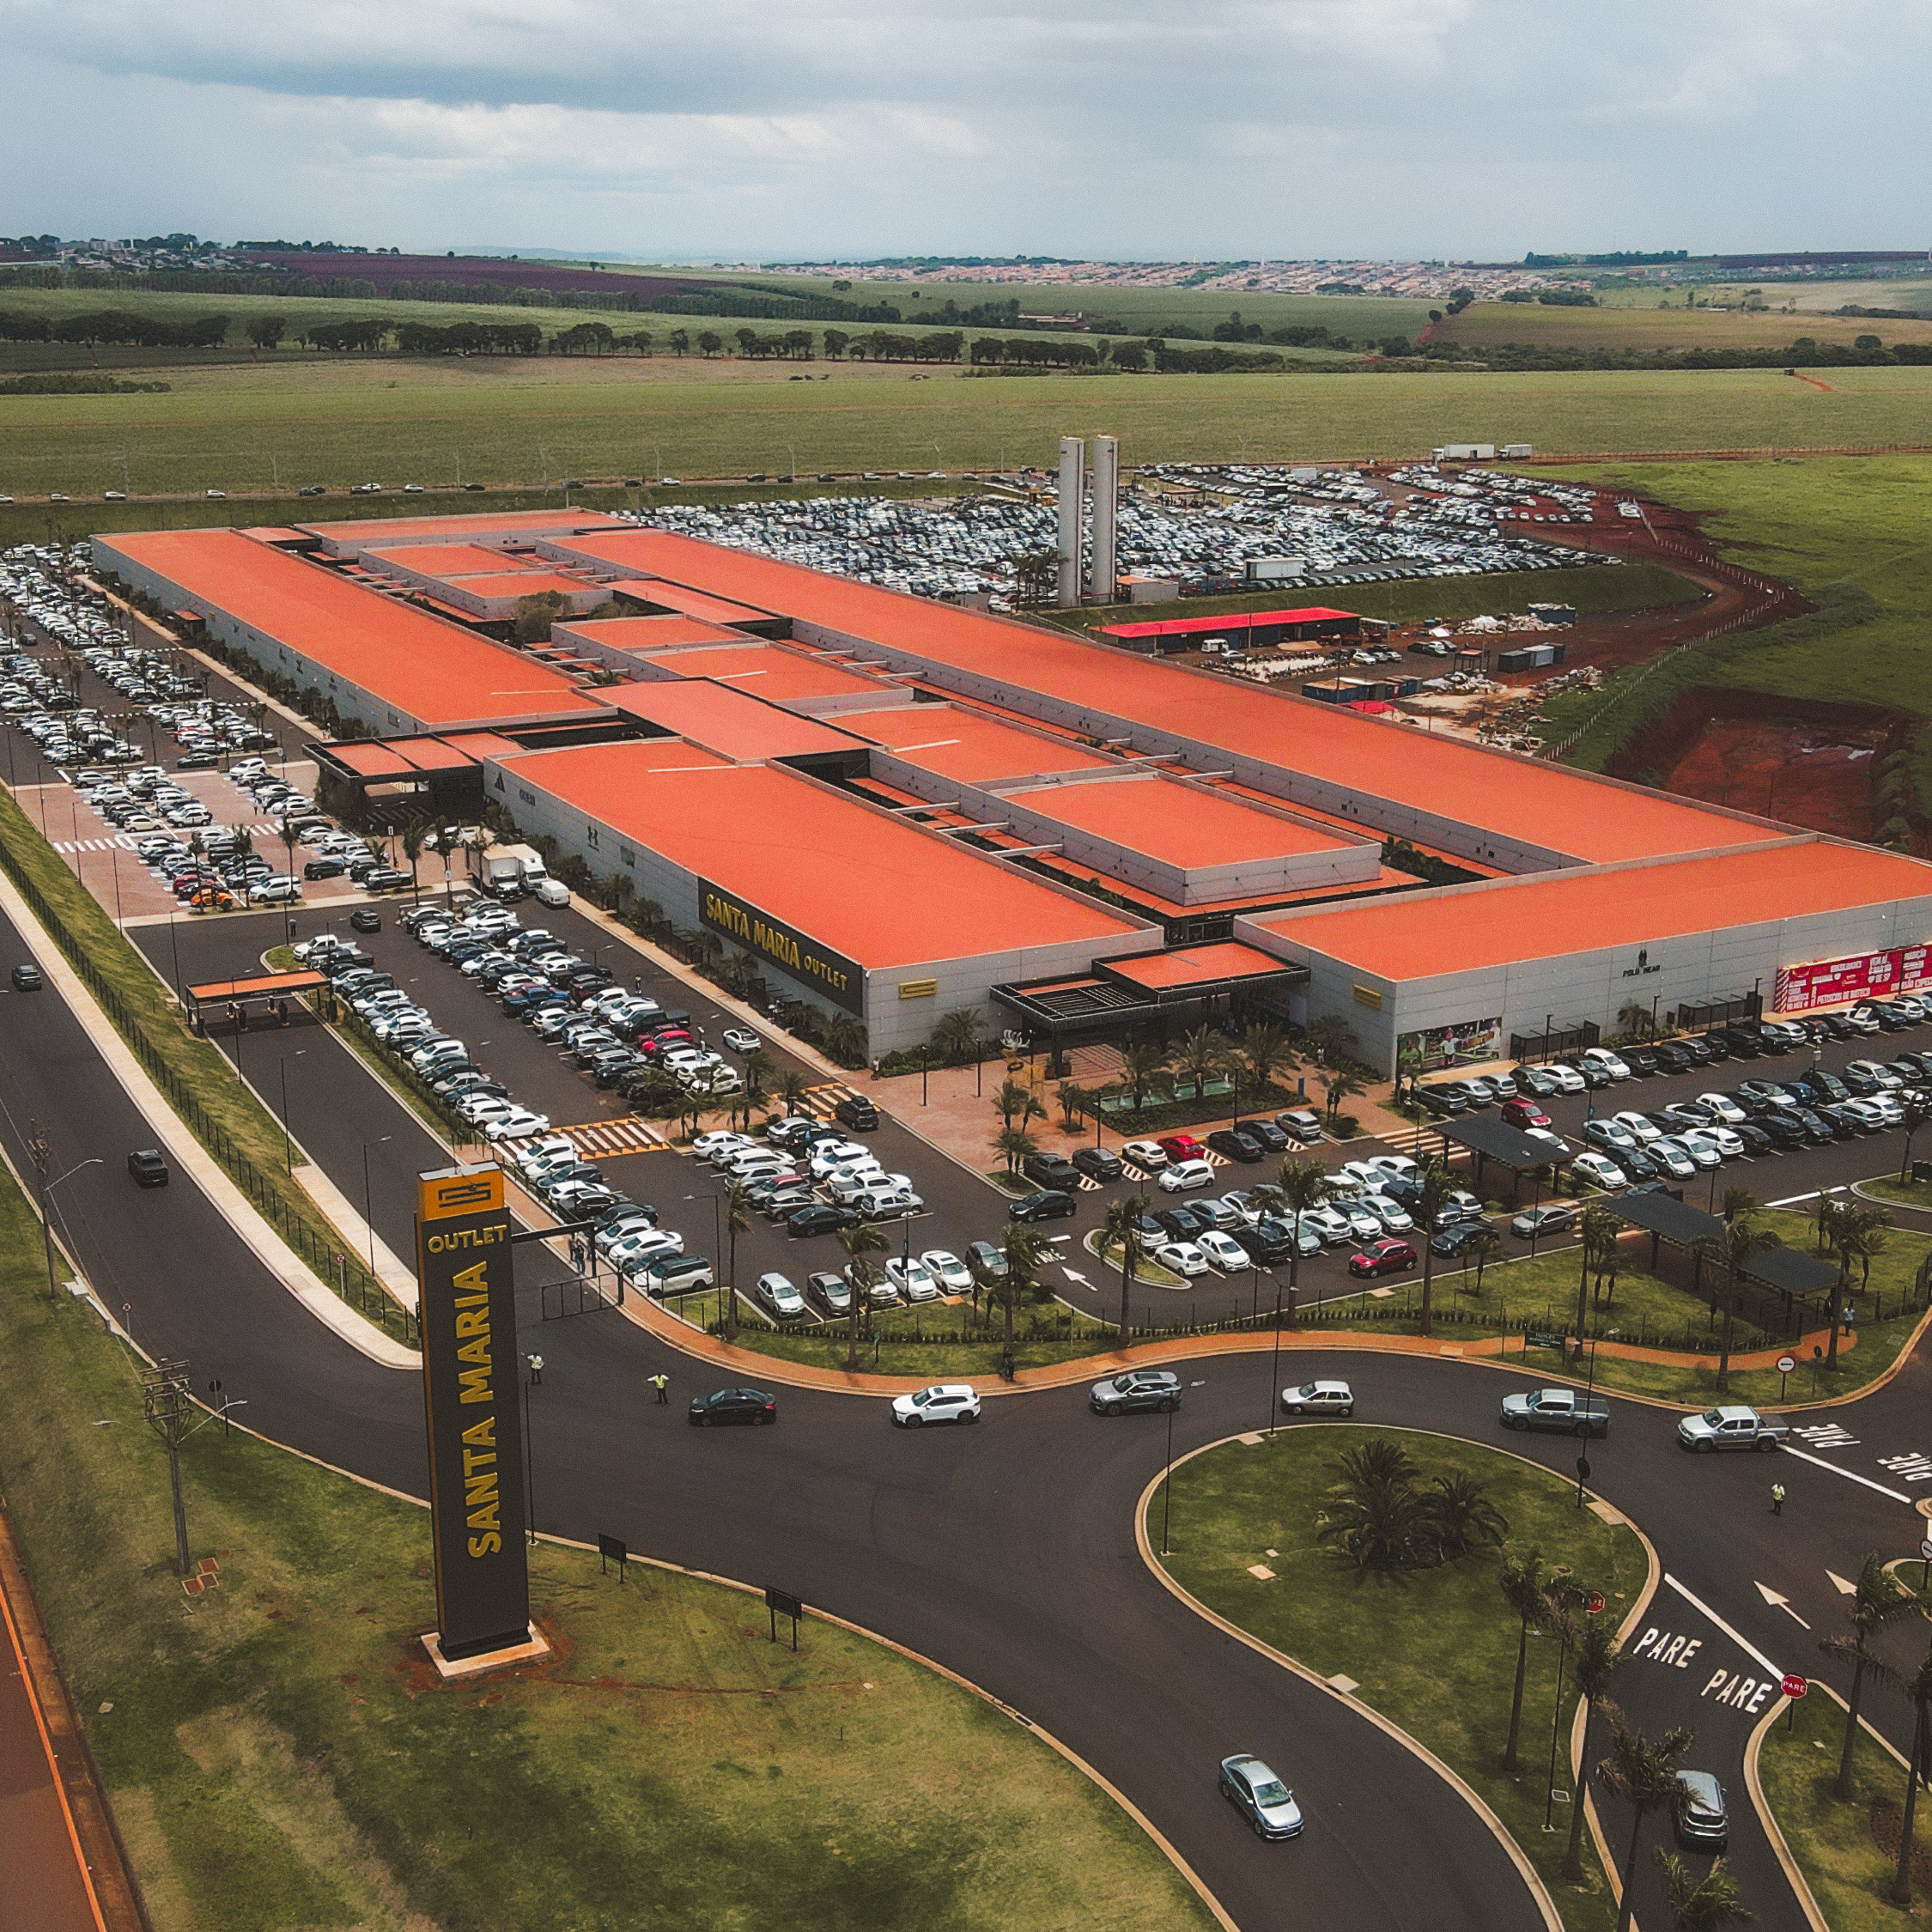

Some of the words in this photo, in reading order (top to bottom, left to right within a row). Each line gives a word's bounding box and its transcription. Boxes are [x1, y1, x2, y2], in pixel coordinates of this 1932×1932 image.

[707, 893, 750, 940] SANTA
[754, 920, 800, 969] MARIA
[804, 955, 848, 990] OUTLET
[1623, 968, 1640, 977] POLO
[1643, 964, 1660, 974] WEAR
[428, 1224, 507, 1254] OUTLET
[453, 1261, 494, 1404] MARIA
[1792, 1423, 1862, 1449] PARE
[462, 1417, 501, 1558] SANTA
[1633, 1628, 1703, 1668] PARE
[1700, 1668, 1773, 1714] PARE
[1783, 1680, 1806, 1693] PARE
